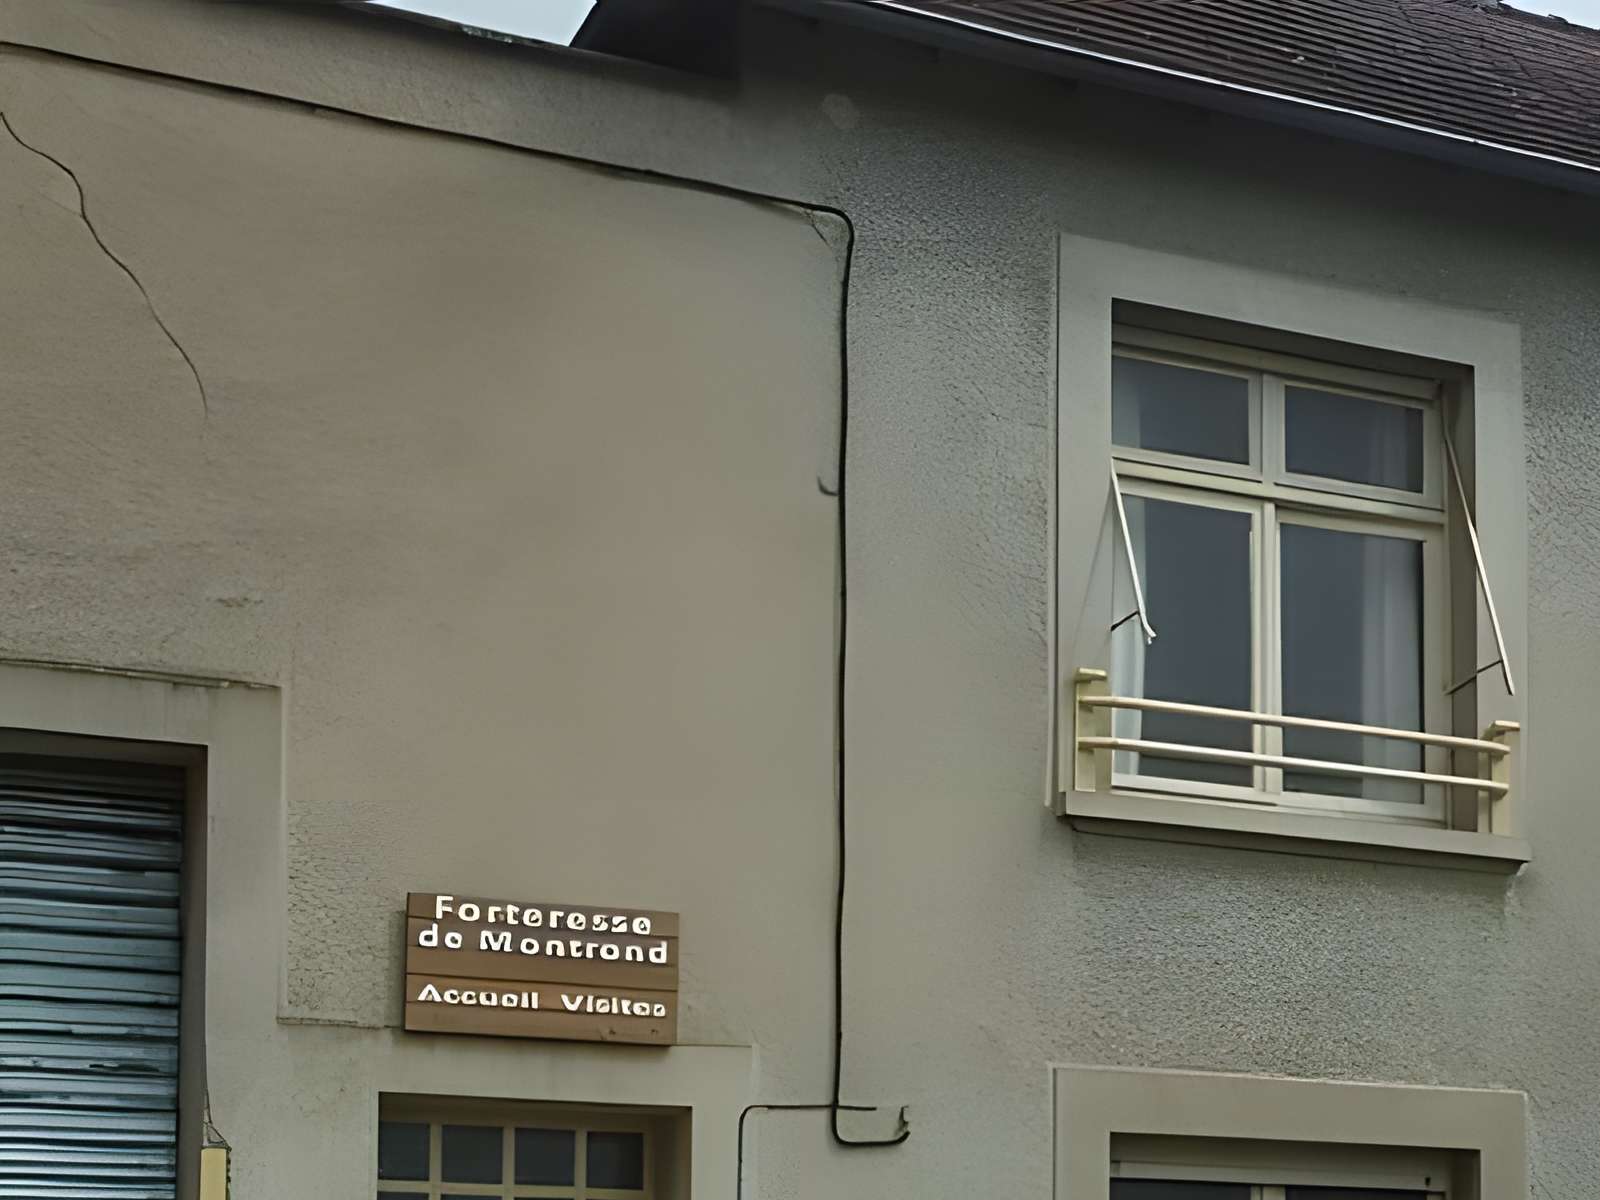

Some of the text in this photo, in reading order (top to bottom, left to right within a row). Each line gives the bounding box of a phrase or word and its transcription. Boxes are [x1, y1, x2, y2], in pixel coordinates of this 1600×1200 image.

[435, 895, 651, 935] Forteresse
[418, 922, 668, 964] de Montrond
[417, 984, 666, 1017] Accueil Visites
